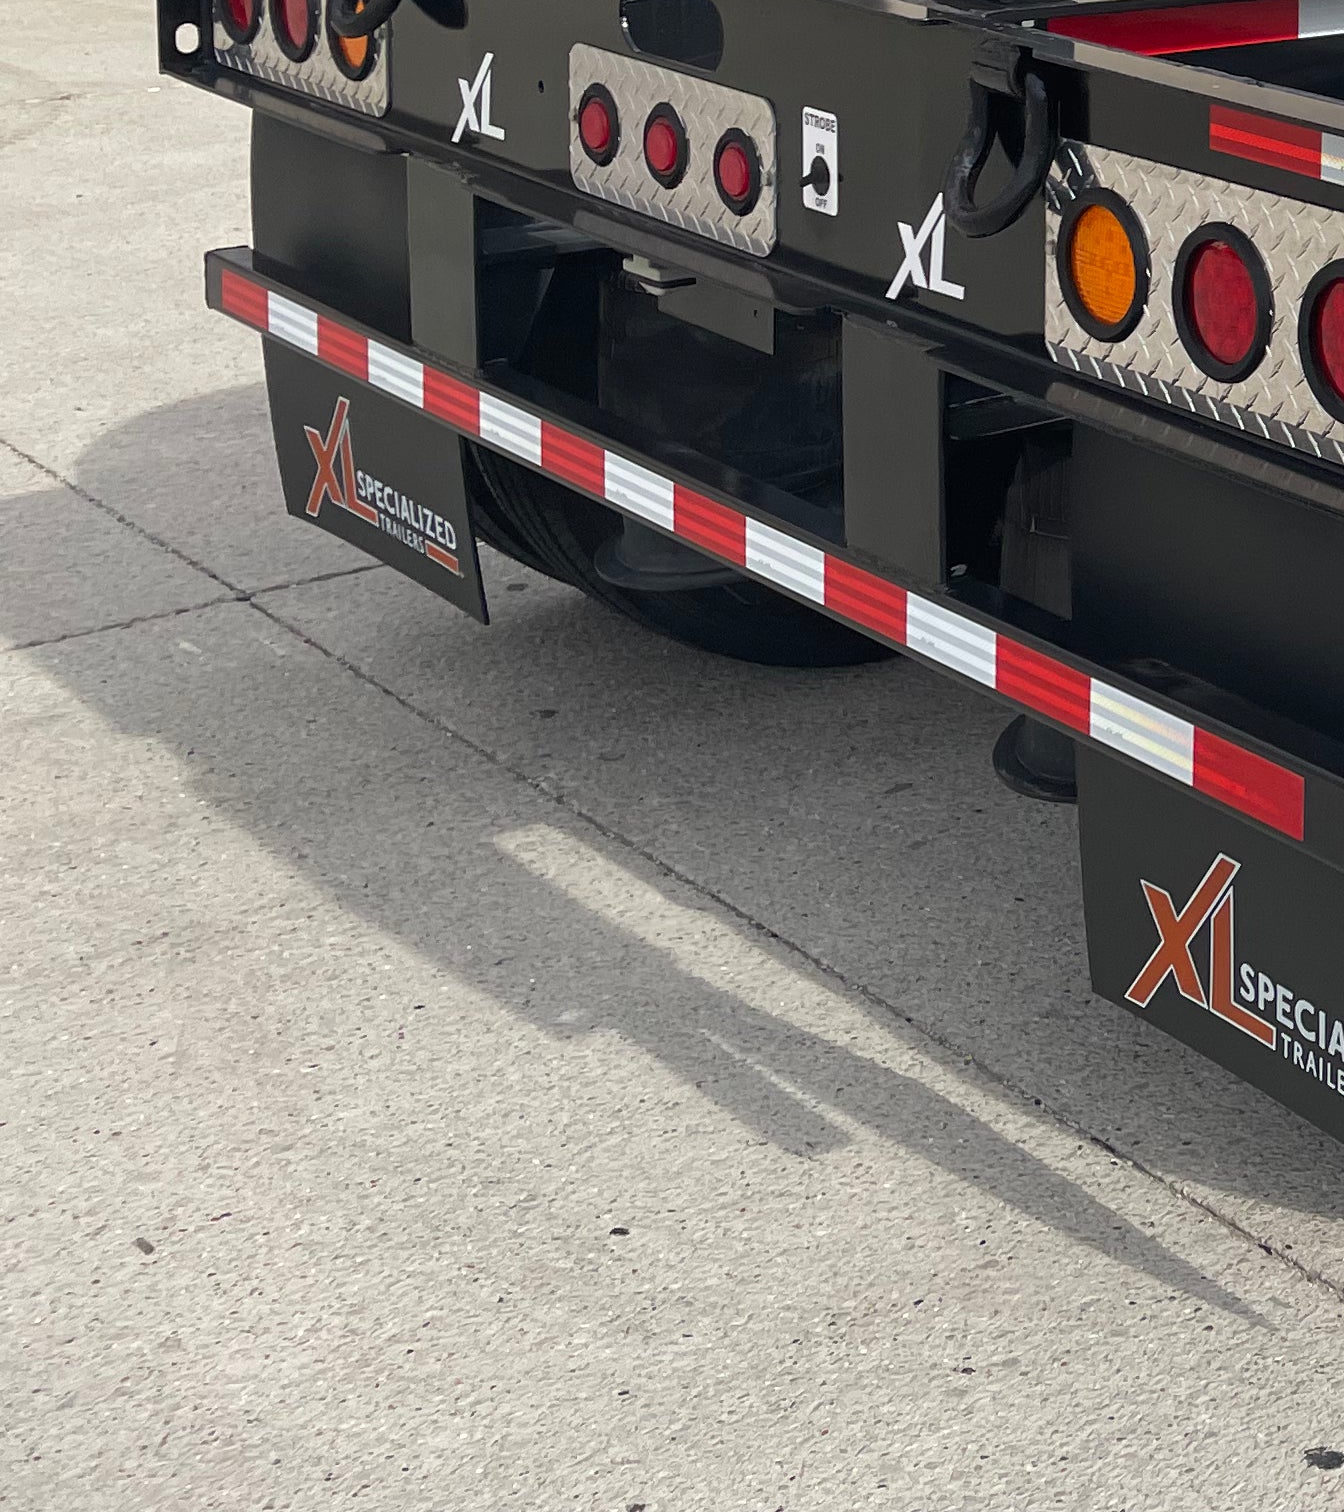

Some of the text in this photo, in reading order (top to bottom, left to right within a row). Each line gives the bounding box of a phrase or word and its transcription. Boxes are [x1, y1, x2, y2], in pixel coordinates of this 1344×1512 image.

[450, 51, 505, 143] XL
[804, 112, 836, 134] STROBE
[885, 192, 966, 300] XL
[303, 395, 457, 550] XL SPECIALIZED
[378, 513, 425, 554] TRAILERS
[1124, 851, 1277, 1051] XL
